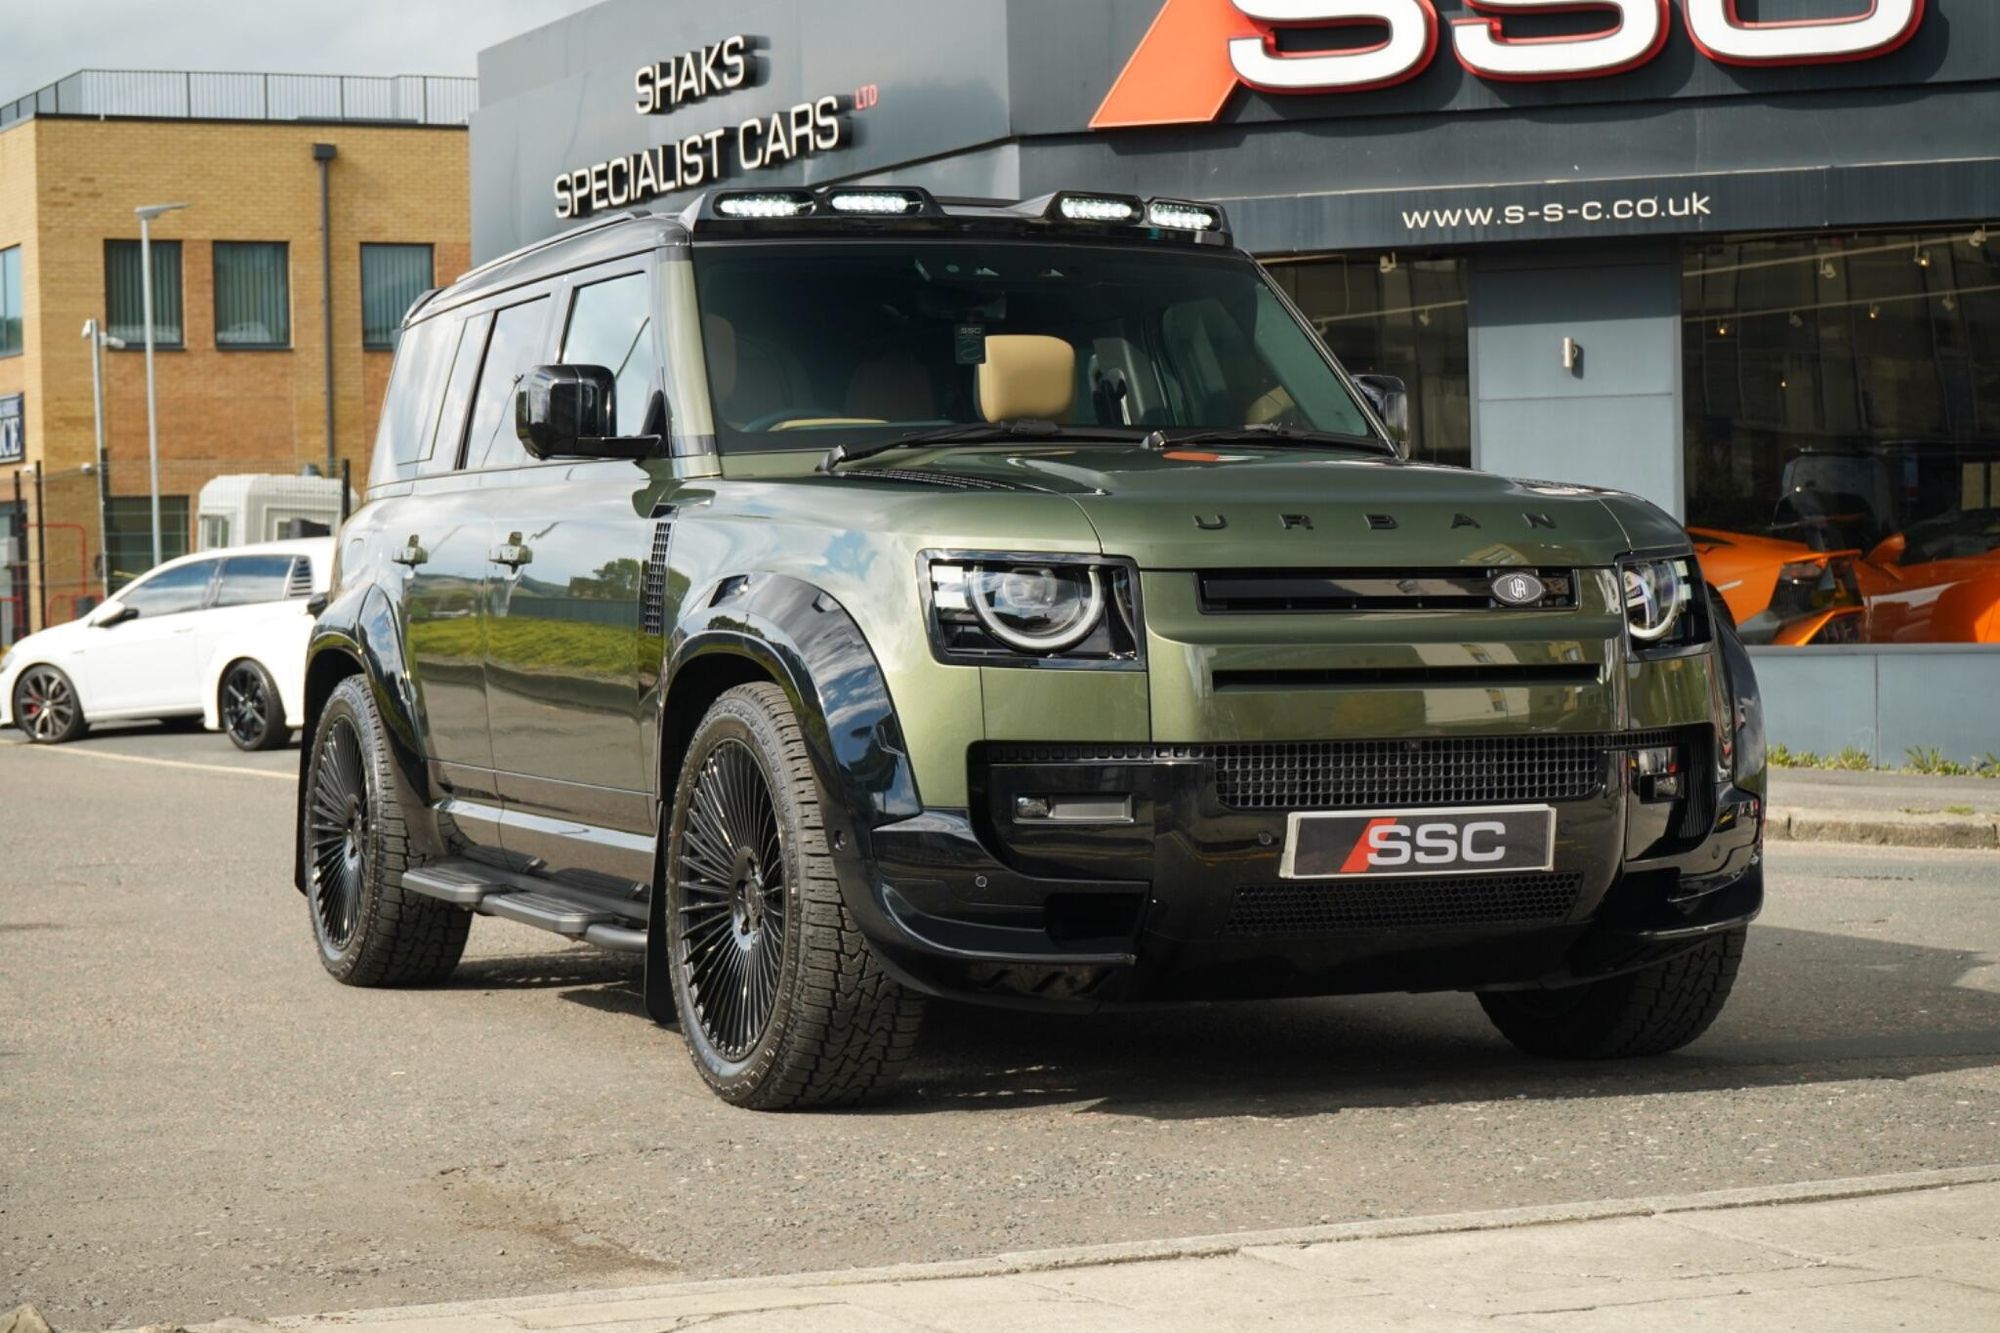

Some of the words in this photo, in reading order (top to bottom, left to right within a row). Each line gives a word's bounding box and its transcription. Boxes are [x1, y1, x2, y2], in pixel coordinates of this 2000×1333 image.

[635, 35, 745, 115] SHAKS
[554, 128, 725, 219] SPECIALIST
[738, 96, 840, 170] CARS
[855, 84, 879, 110] LTD
[1401, 191, 1712, 229] www.s-s-c.co.uk
[1193, 512, 1557, 531] URBAN
[1366, 821, 1507, 866] SSC
